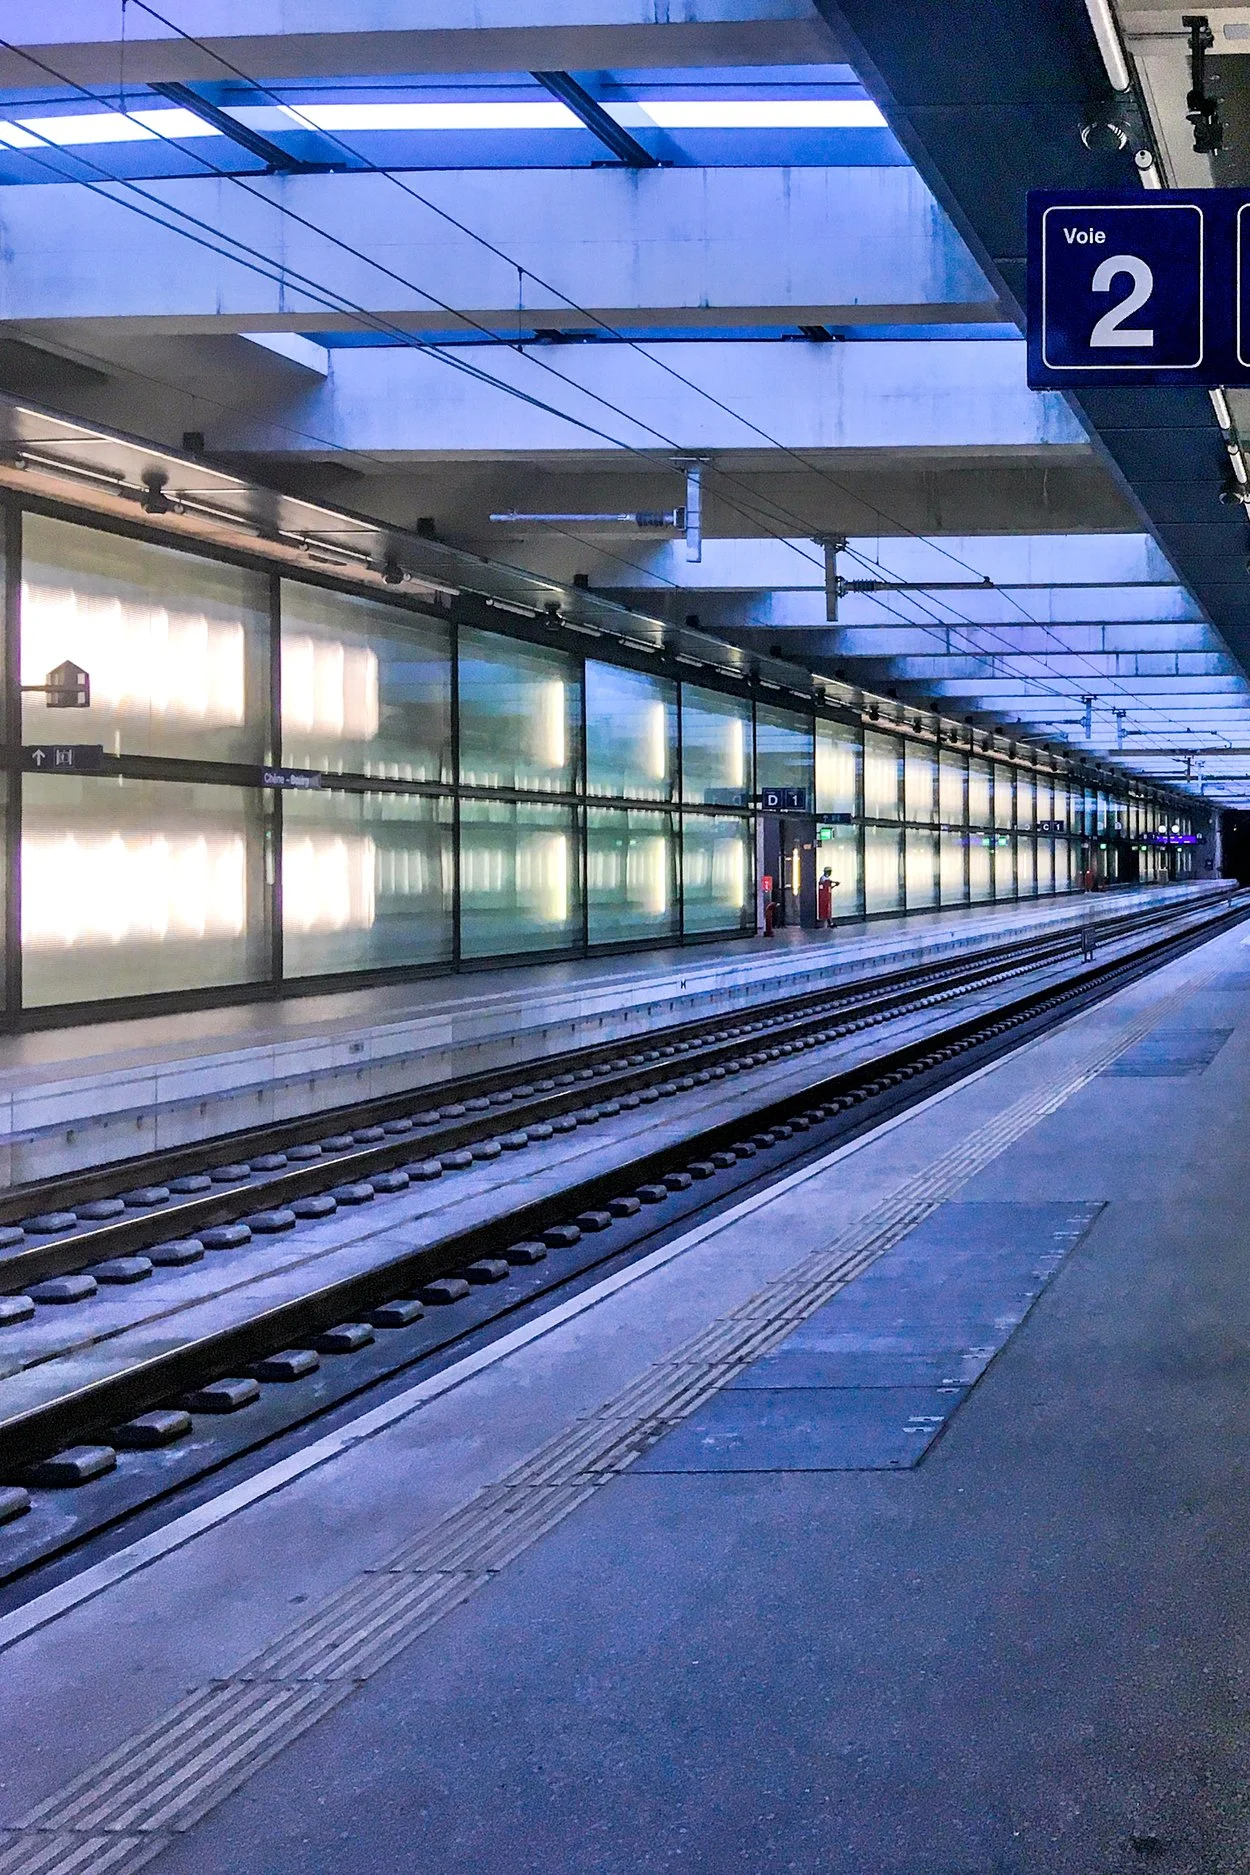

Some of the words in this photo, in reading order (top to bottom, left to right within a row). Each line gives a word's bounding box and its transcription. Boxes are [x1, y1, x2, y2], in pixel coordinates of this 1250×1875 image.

[1063, 227, 1107, 244] Voie
[1089, 254, 1154, 347] 2
[768, 794, 778, 806] D
[792, 794, 798, 806] 1
[1043, 823, 1049, 831] C
